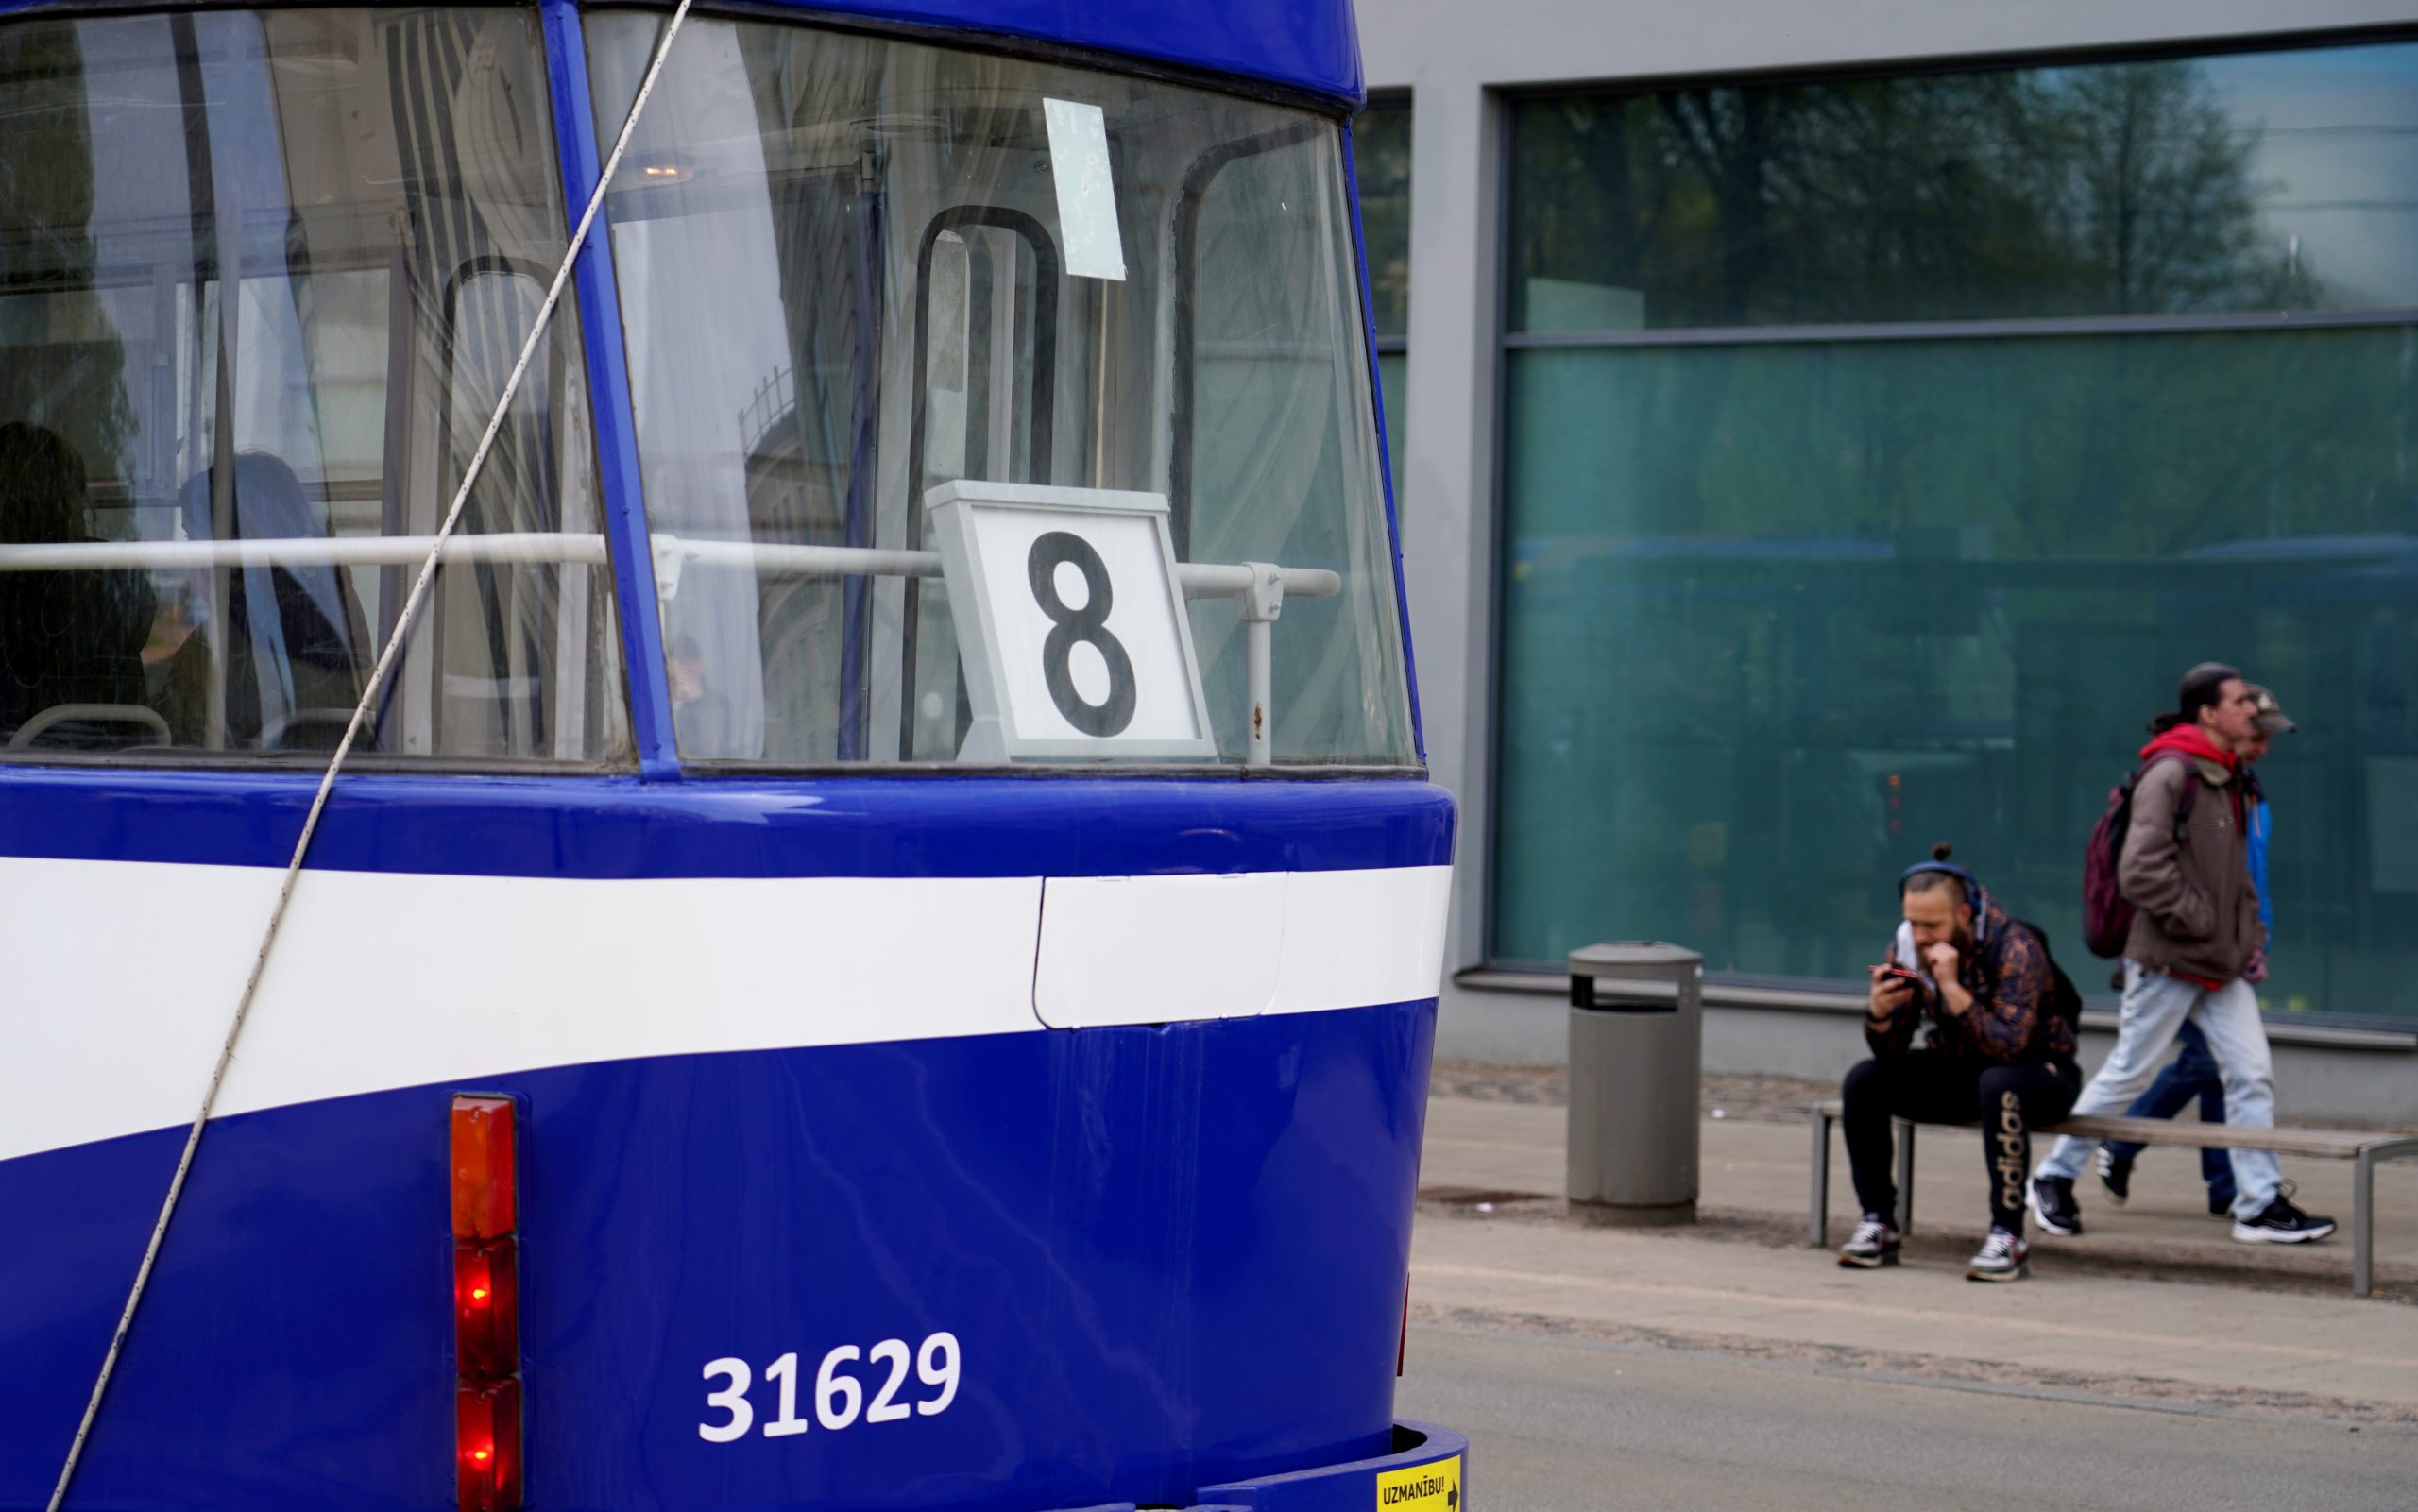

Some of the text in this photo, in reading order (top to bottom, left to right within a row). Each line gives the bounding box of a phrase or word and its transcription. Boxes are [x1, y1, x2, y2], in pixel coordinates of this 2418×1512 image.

[1028, 531, 1136, 738] 8
[1995, 1090, 2025, 1211] adidas
[699, 1332, 961, 1443] 31629
[1383, 1475, 1445, 1504] UZMANĪBU!
